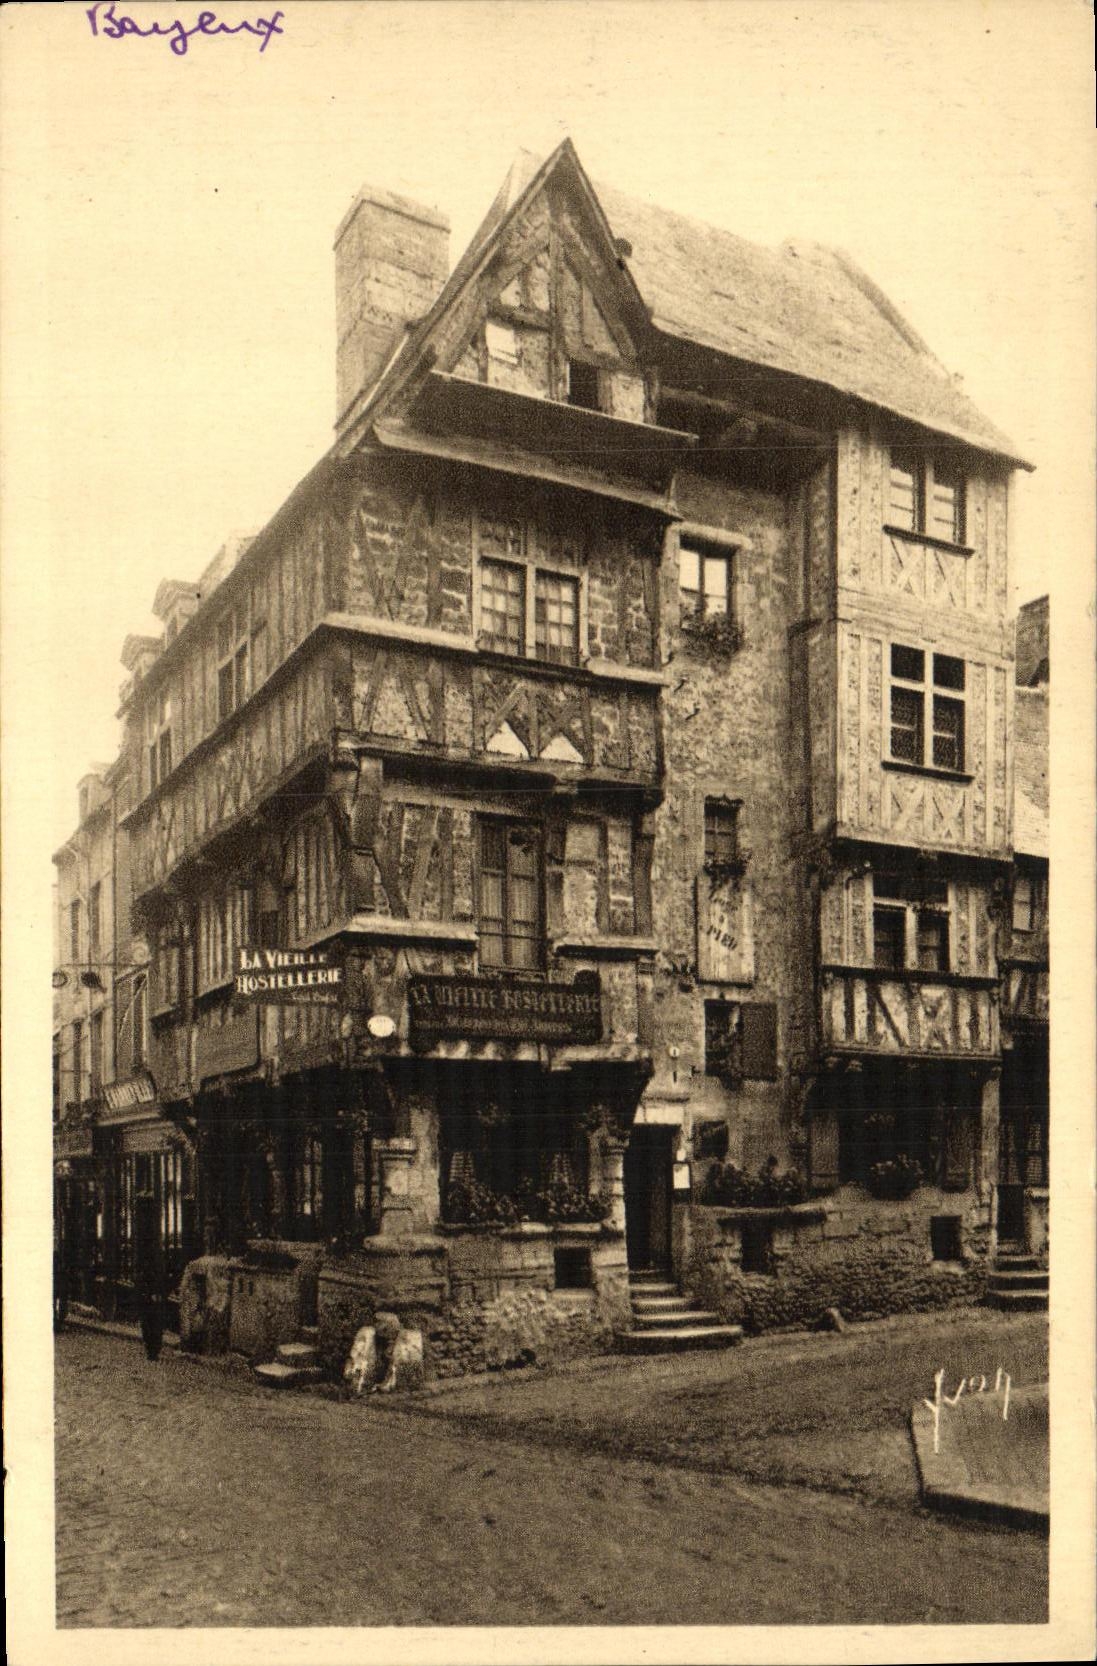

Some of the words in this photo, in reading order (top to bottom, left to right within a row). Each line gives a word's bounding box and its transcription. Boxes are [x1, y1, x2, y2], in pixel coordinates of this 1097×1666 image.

[86, 1, 285, 56] Bayeux
[240, 948, 262, 970] LA
[264, 948, 328, 969] VIEILLE
[235, 967, 342, 995] HOSTELLERIE
